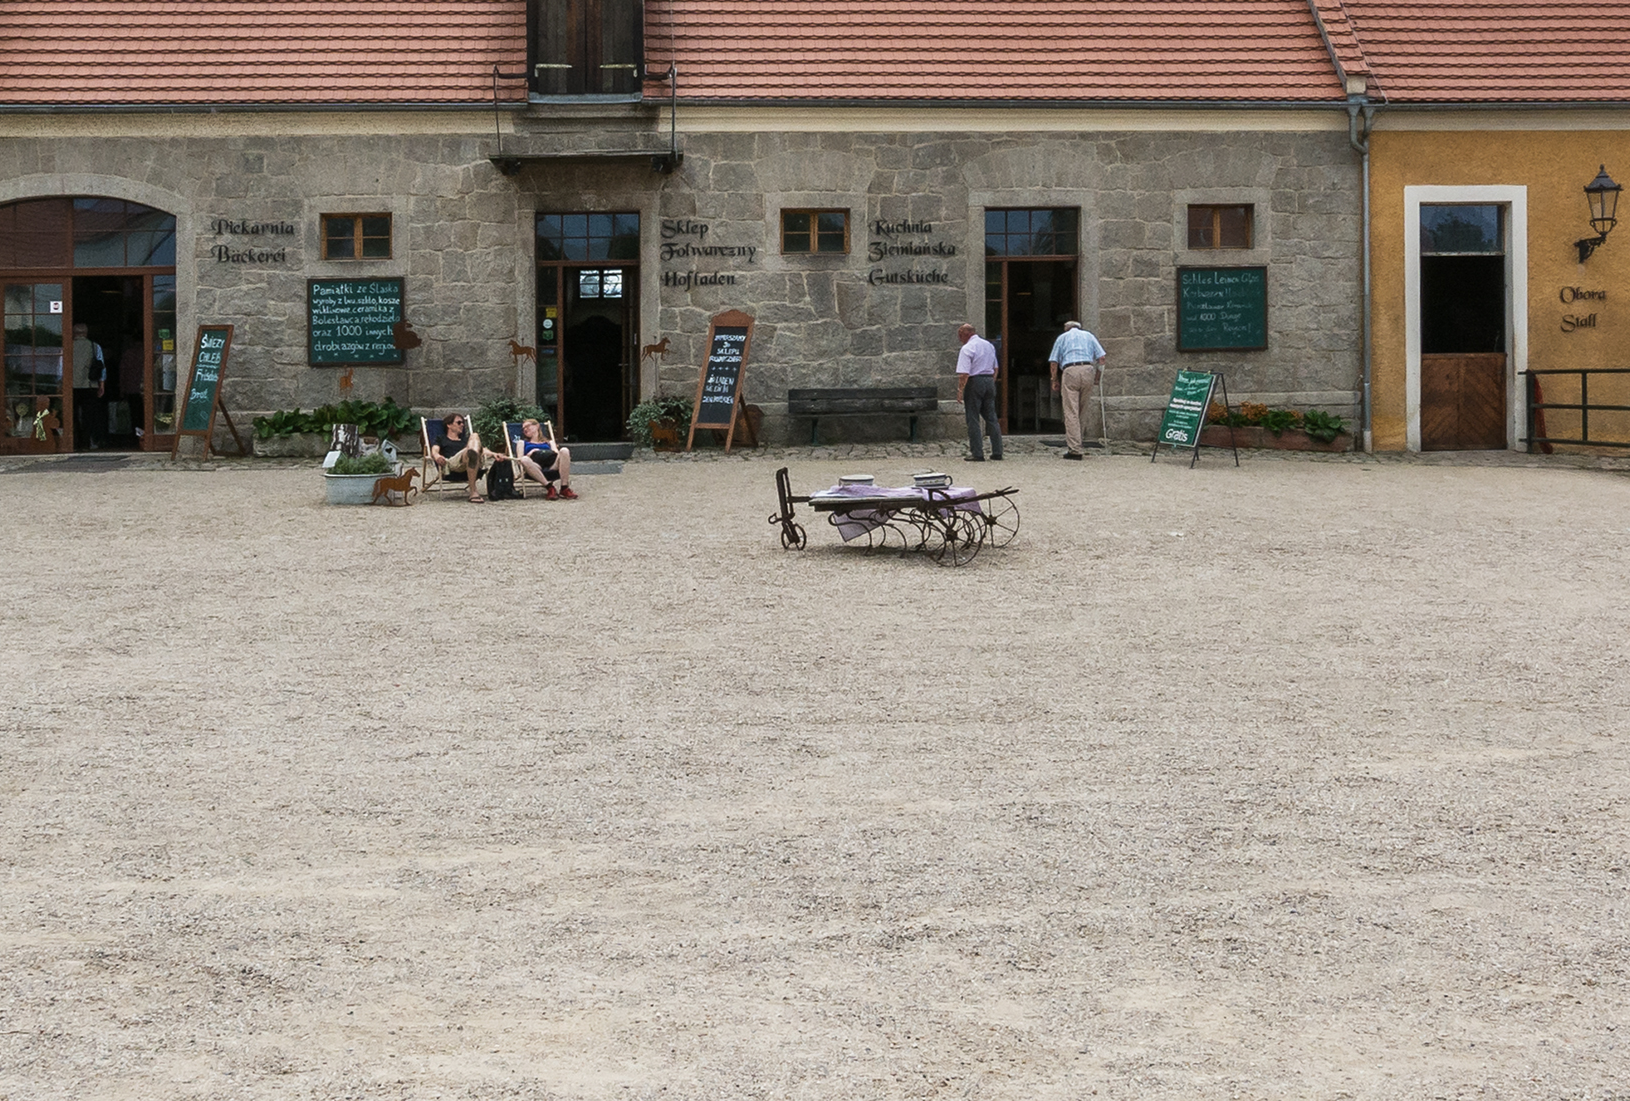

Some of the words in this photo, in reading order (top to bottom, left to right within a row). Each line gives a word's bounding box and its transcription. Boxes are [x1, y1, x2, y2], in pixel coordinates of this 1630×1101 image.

[211, 219, 295, 235] Piekarnia
[660, 219, 709, 239] Sklep
[869, 218, 932, 239] Kuchnia
[210, 244, 286, 263] Bäckerei
[660, 242, 757, 263] Folwarczny
[869, 241, 956, 263] Ziemiańska
[661, 270, 737, 292] Hofladen
[869, 268, 948, 286] Gutsküche
[356, 286, 368, 294] ze
[1560, 286, 1606, 304] Obora
[312, 296, 336, 307] wyroby
[378, 295, 400, 305] kosze
[1560, 312, 1598, 332] Stall
[312, 329, 332, 337] oraz
[335, 325, 363, 337] 1000
[365, 324, 394, 339] innych
[314, 340, 364, 354] drobiazgów
[1165, 428, 1188, 442] Gratis
